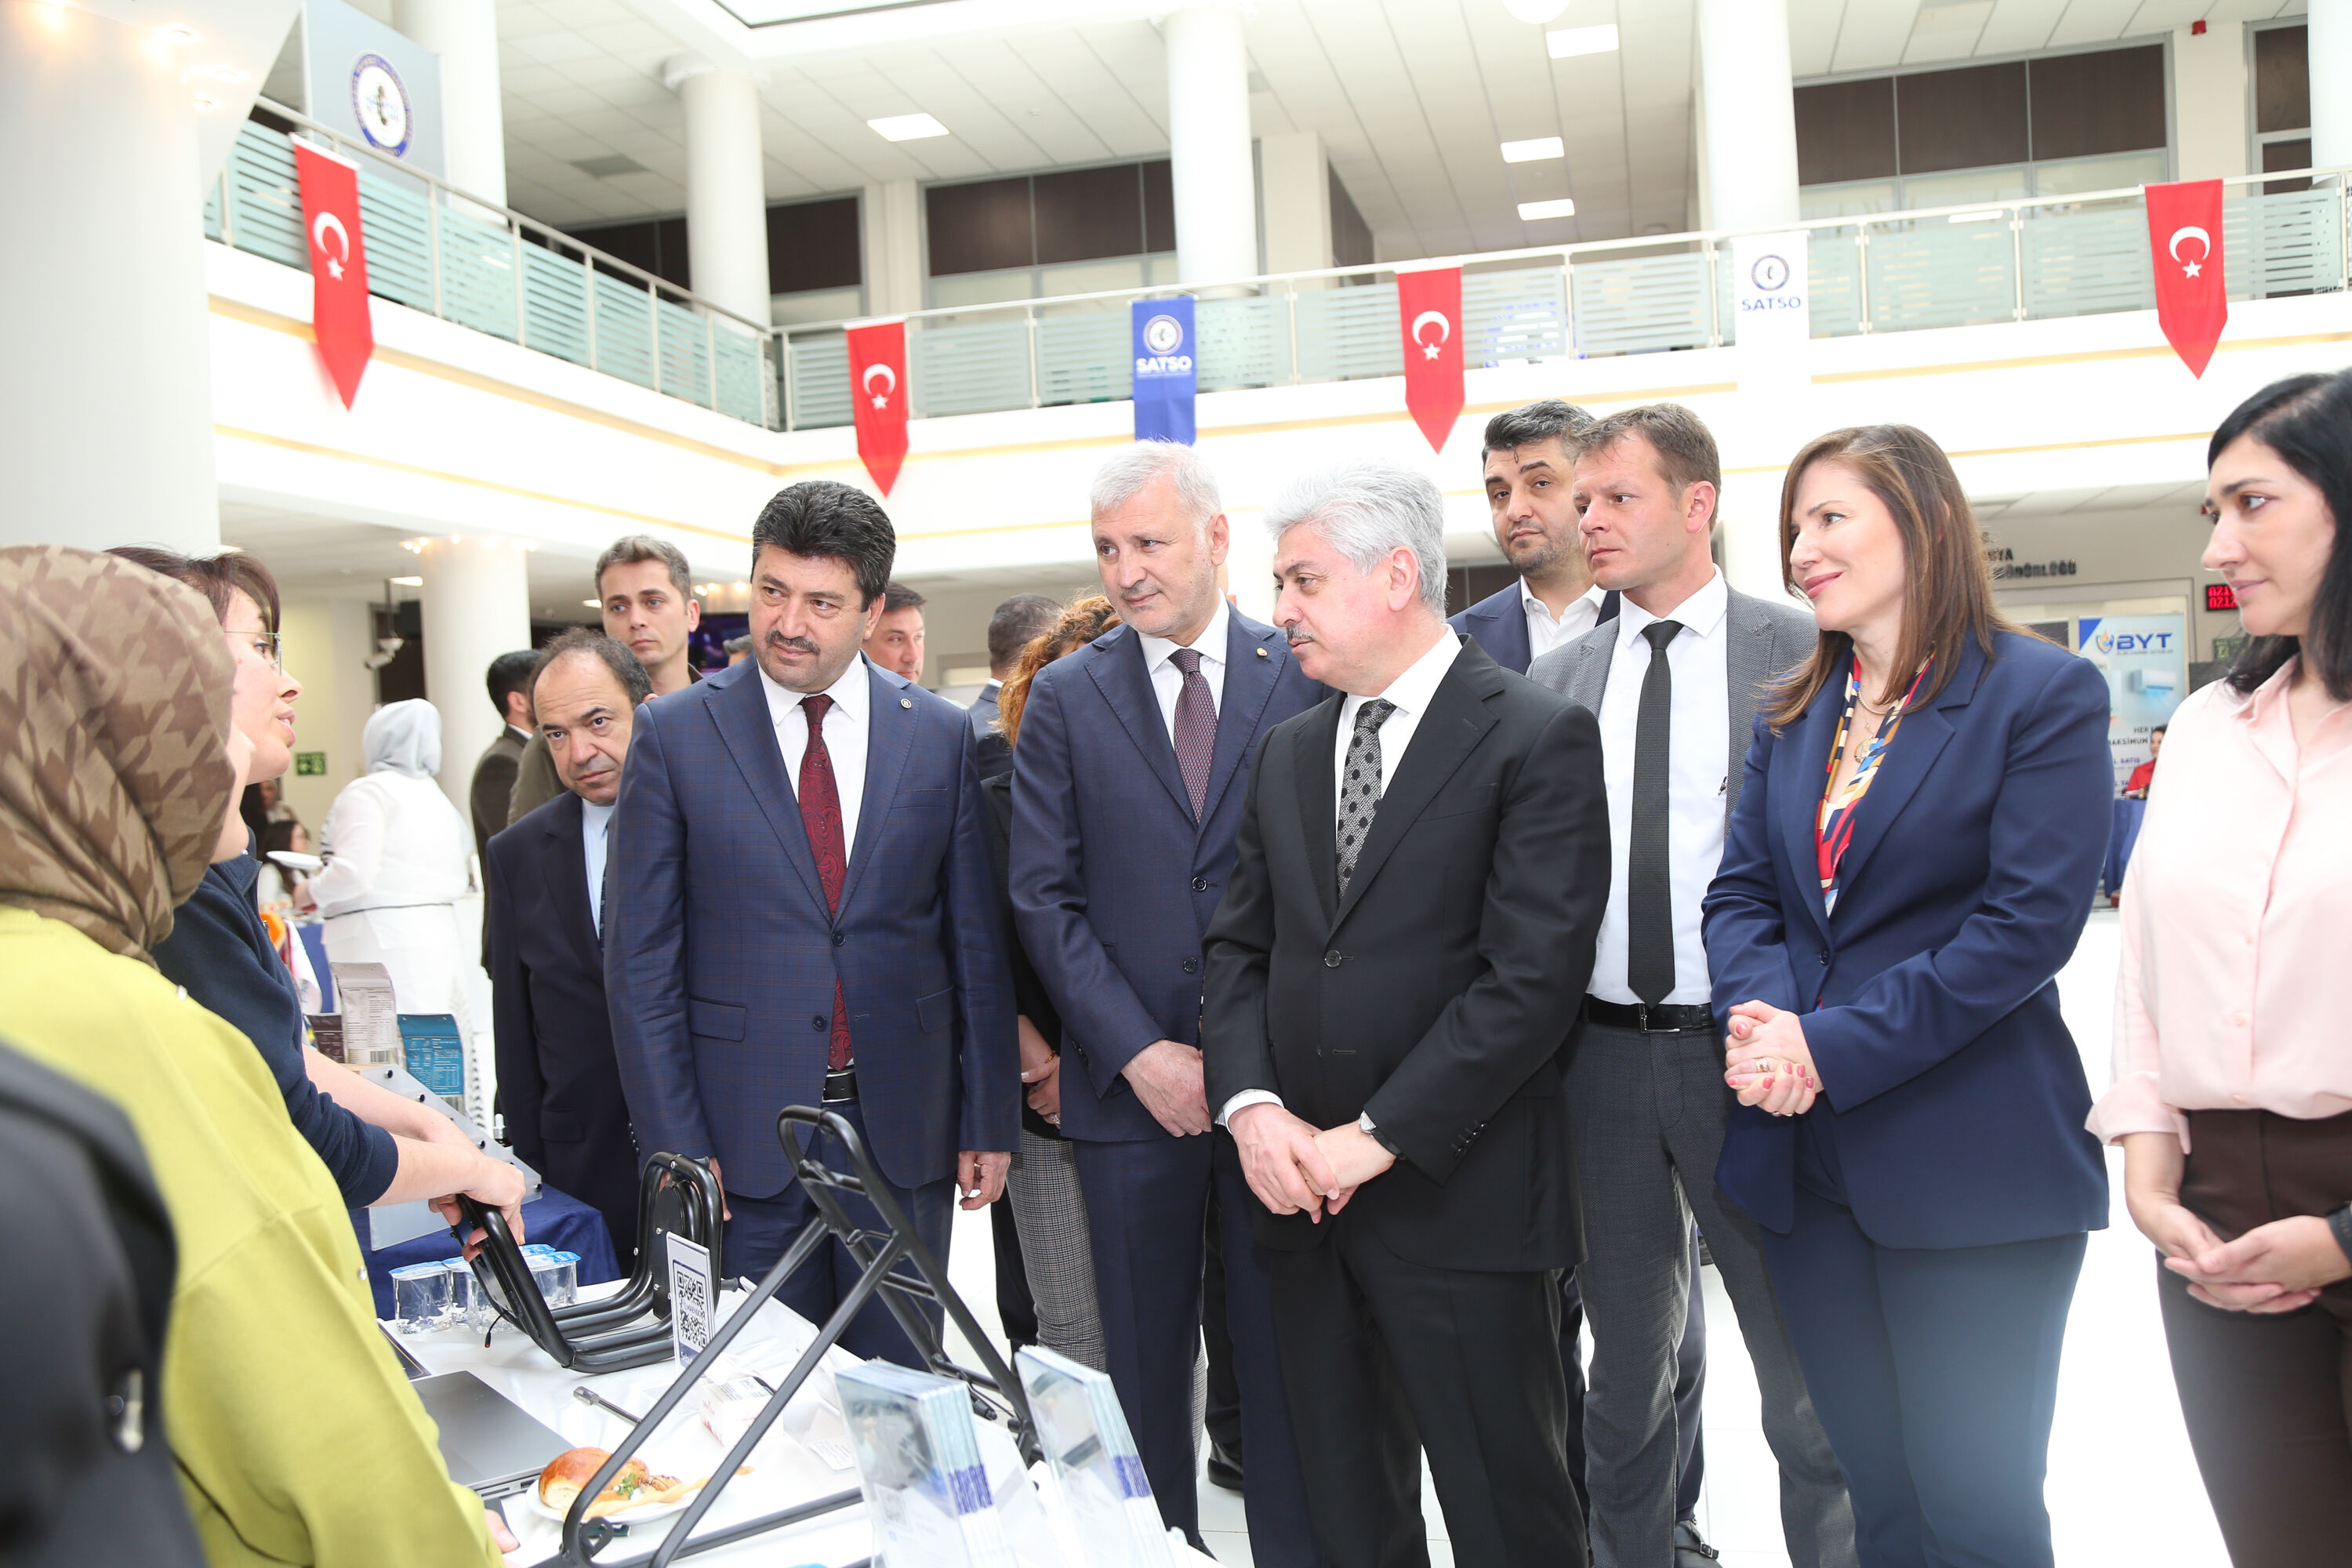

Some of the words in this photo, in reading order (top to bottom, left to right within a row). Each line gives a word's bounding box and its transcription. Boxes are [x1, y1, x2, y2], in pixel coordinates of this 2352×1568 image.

[1742, 296, 1801, 311] SATSO
[1135, 355, 1192, 372] SATSO
[2117, 632, 2172, 650] BYT
